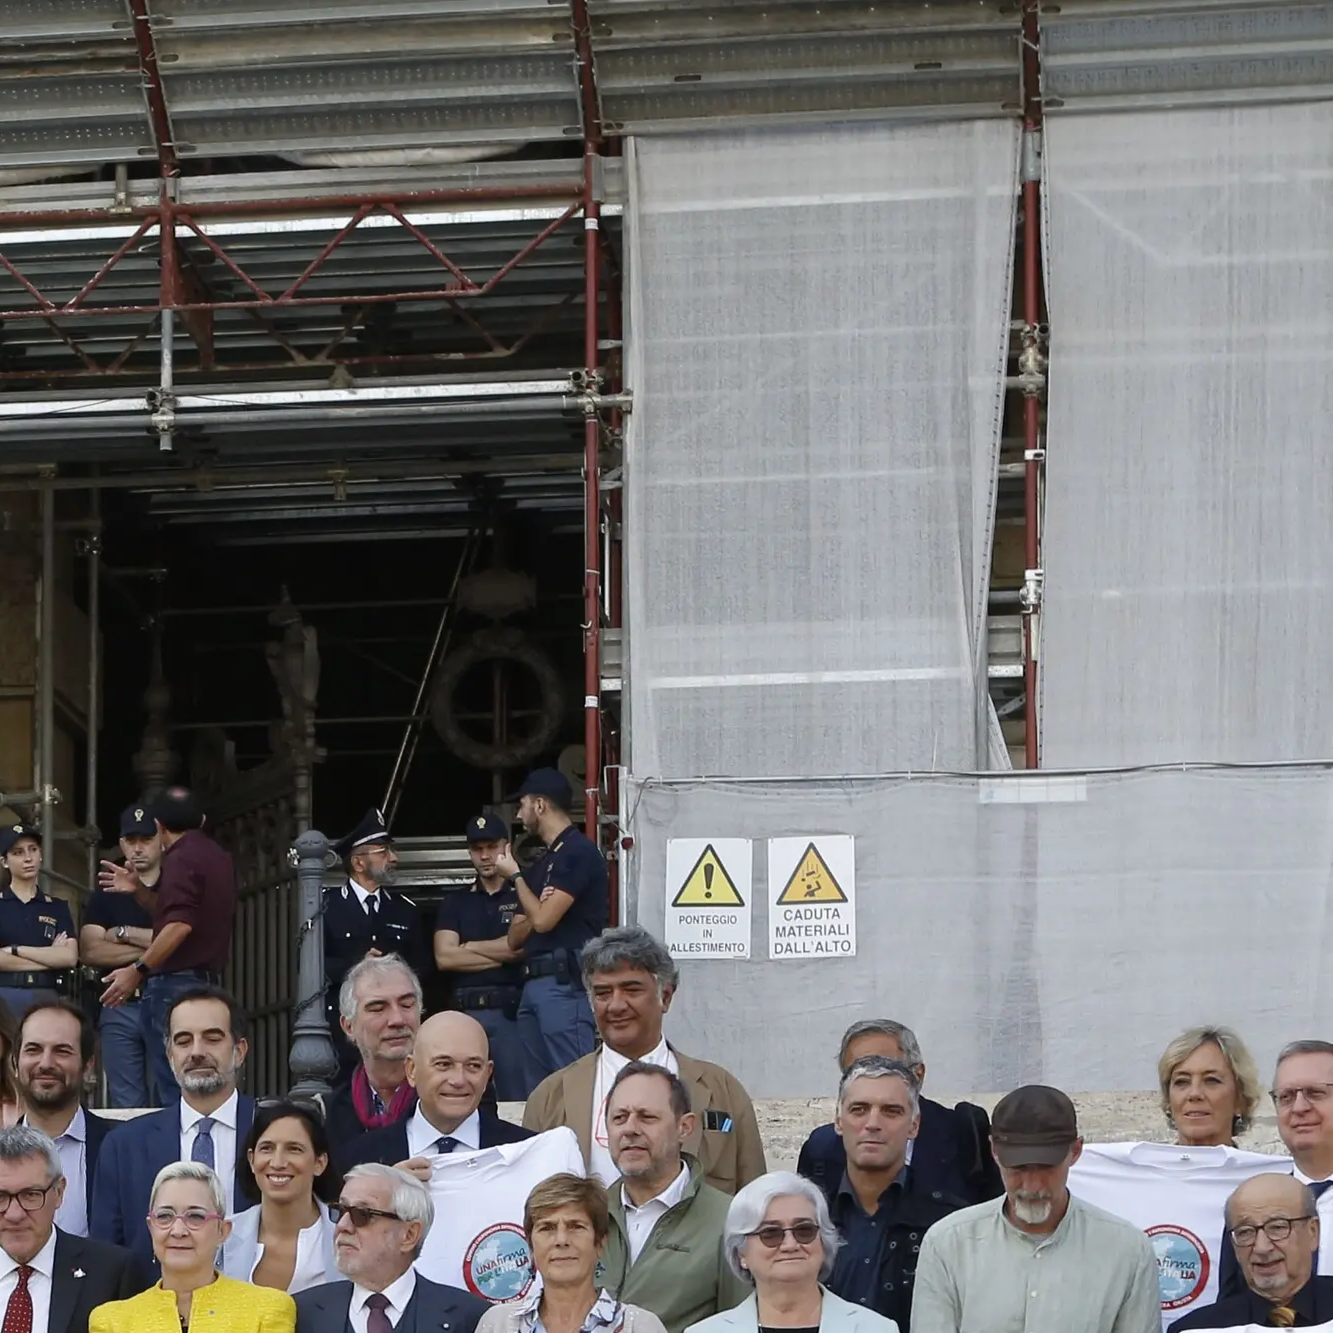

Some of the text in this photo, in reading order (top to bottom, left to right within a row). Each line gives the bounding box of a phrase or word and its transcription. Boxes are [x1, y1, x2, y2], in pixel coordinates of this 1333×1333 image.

[679, 915, 737, 925] PONTEGGIO
[783, 909, 840, 921] CADUTA
[702, 928, 713, 938] IN
[775, 924, 850, 938] MATERIALI
[670, 942, 745, 953] ALLESTIMENTO
[774, 940, 851, 954] DALL'ALTO
